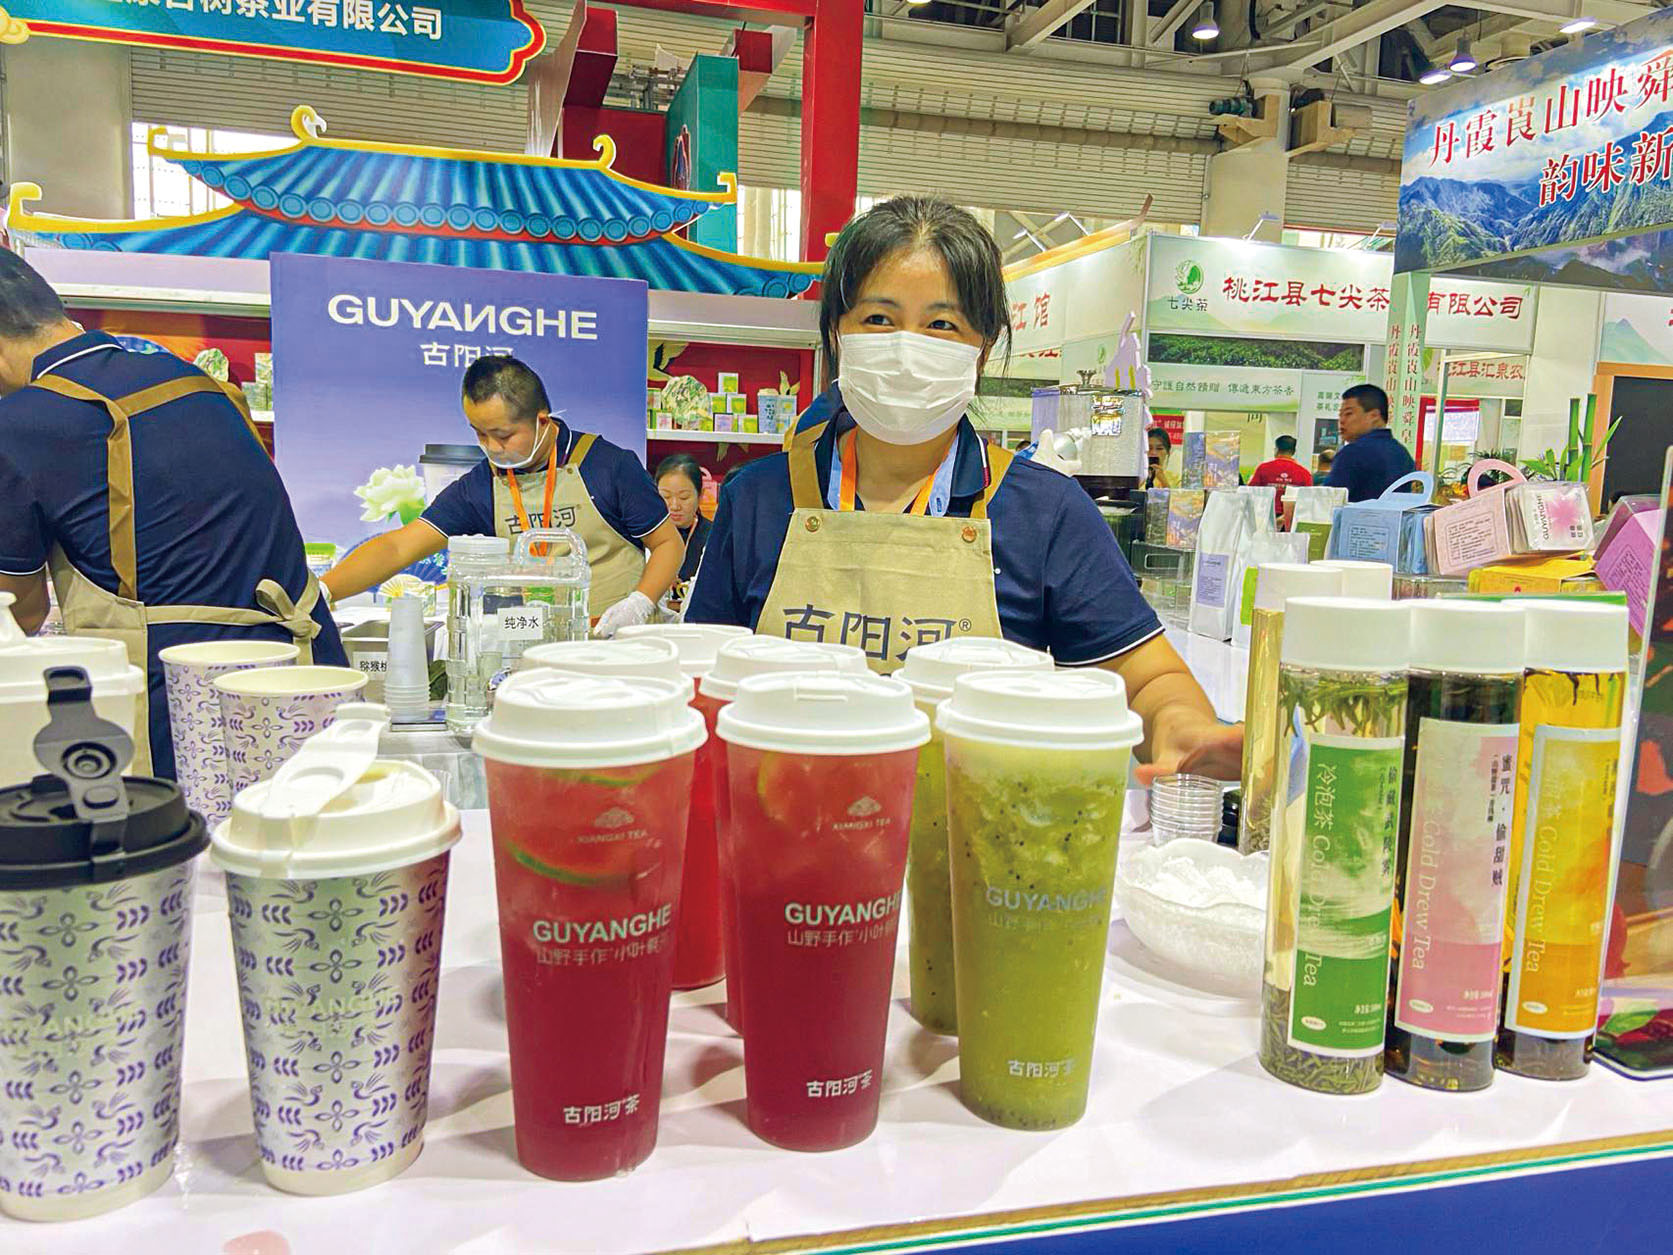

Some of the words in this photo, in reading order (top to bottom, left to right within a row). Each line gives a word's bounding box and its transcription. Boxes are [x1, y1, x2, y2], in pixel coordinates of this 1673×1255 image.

[504, 615, 539, 630] 纯净水
[1313, 763, 1338, 831] 冷泡茶
[1535, 825, 1558, 873] Cold
[1416, 873, 1437, 931] Drew
[533, 903, 672, 943] GUYANGHE
[1303, 953, 1323, 987] Tea
[1411, 935, 1432, 970] Tea
[1525, 939, 1546, 973] Tea
